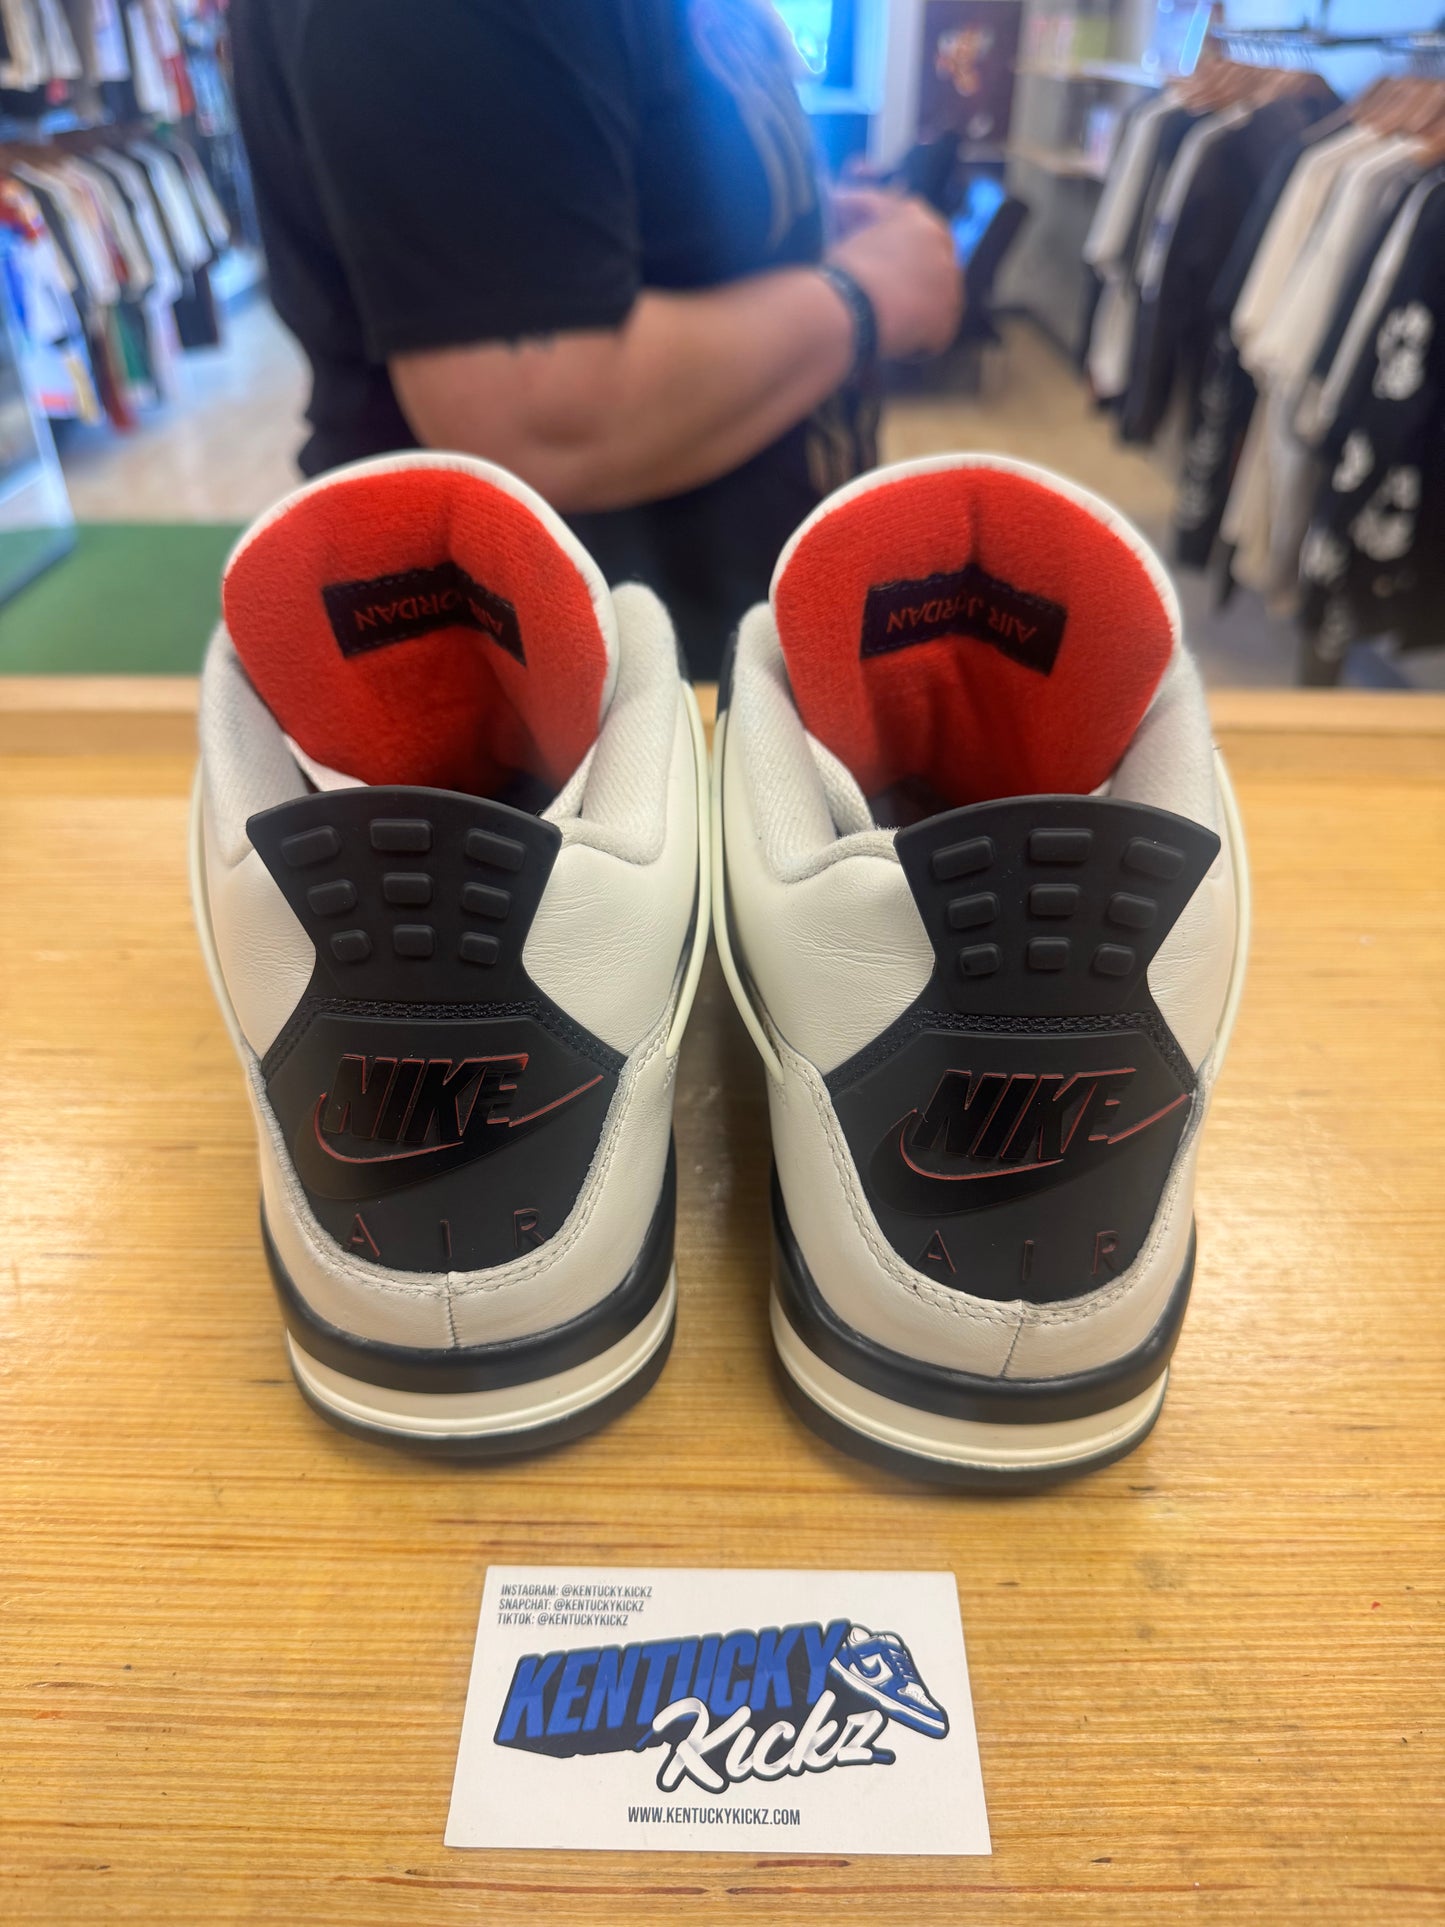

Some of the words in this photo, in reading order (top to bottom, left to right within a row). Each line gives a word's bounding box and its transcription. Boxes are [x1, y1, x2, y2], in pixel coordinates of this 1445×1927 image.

[353, 591, 463, 633] ORDAN
[886, 591, 985, 634] JORDAN
[986, 606, 1038, 645] AIR
[323, 1053, 529, 1143] NIKE
[911, 1067, 1136, 1160] NIKE
[345, 1207, 546, 1260] AIR
[914, 1230, 1121, 1281] AIR
[499, 1598, 552, 1610] SNAPCHAT:
[554, 1598, 645, 1612] @KENTUCKYKICKZ
[501, 1583, 559, 1596] INSTAGRAM:
[561, 1584, 653, 1598] @KENTUCKY.KICKZ
[497, 1612, 535, 1625] TIKTOK:
[537, 1612, 629, 1626] @KENTUCKYKICKZ
[499, 1620, 850, 1742] KENTUCKY
[653, 1689, 886, 1790] Kickz
[628, 1806, 801, 1826] WWW.KENTUCKYKICKZ.COM
